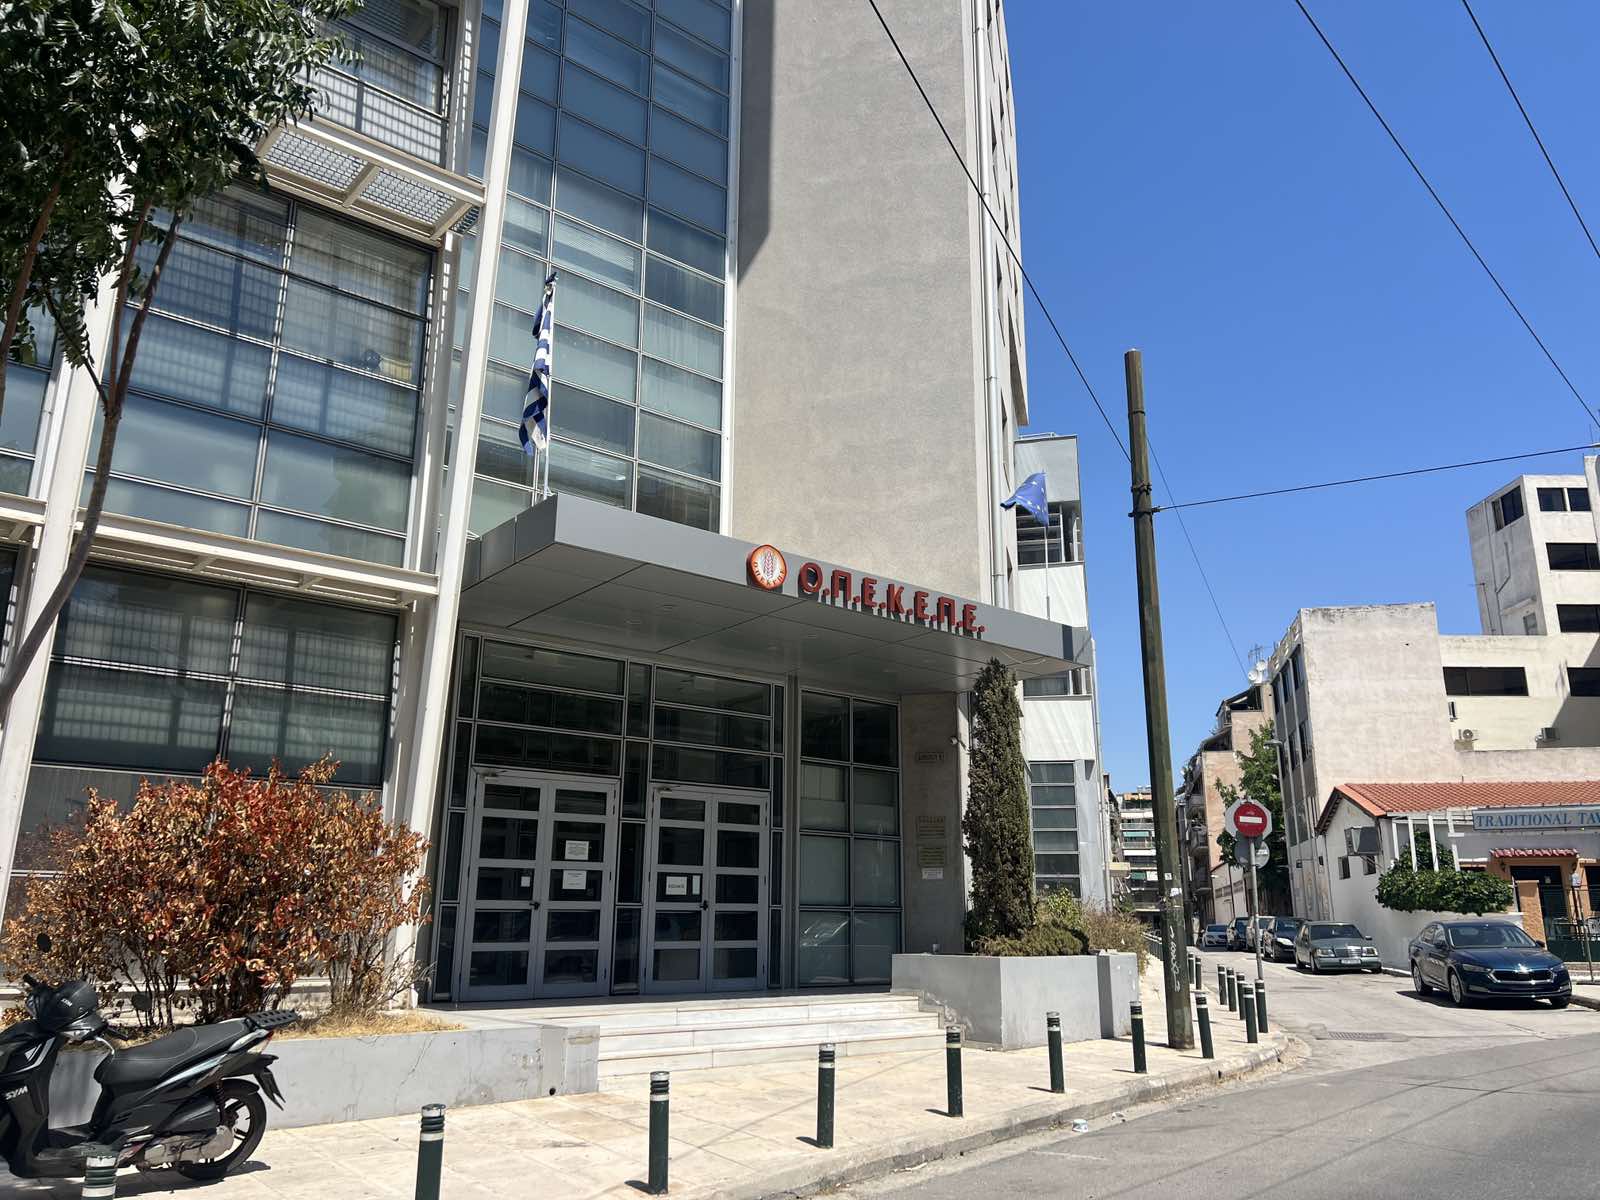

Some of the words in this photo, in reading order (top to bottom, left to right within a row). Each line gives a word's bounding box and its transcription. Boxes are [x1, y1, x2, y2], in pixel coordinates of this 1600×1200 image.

[798, 562, 985, 632] Ο.Π.Ε.Κ.Ε.Π.Ε.
[1477, 813, 1571, 827] TRADITIONAL
[5, 1085, 28, 1100] SYM
